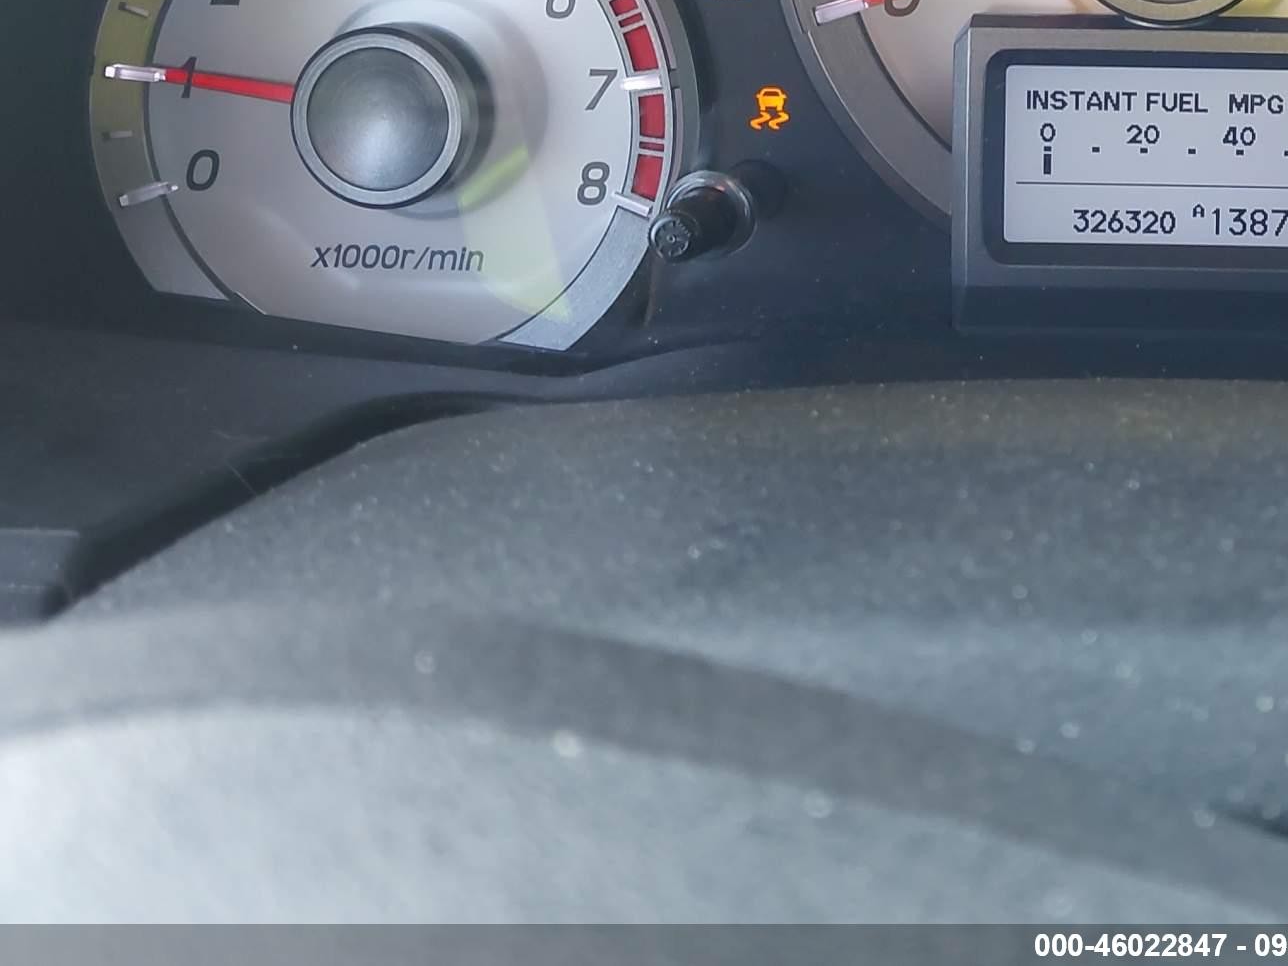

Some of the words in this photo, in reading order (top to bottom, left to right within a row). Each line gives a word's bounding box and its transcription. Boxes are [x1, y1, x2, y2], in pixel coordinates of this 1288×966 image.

[176, 57, 197, 98] 1
[584, 69, 618, 111] 7
[1026, 90, 1137, 112] INSTANT
[1146, 92, 1208, 113] FUEL
[1229, 94, 1284, 115] MPG
[1040, 123, 1055, 142] 0
[1127, 125, 1160, 144] 20
[1223, 127, 1256, 146] 40
[186, 149, 220, 191] 0
[577, 162, 609, 206] 8
[1073, 209, 1176, 234] 326320
[311, 244, 484, 272] x1000r/min
